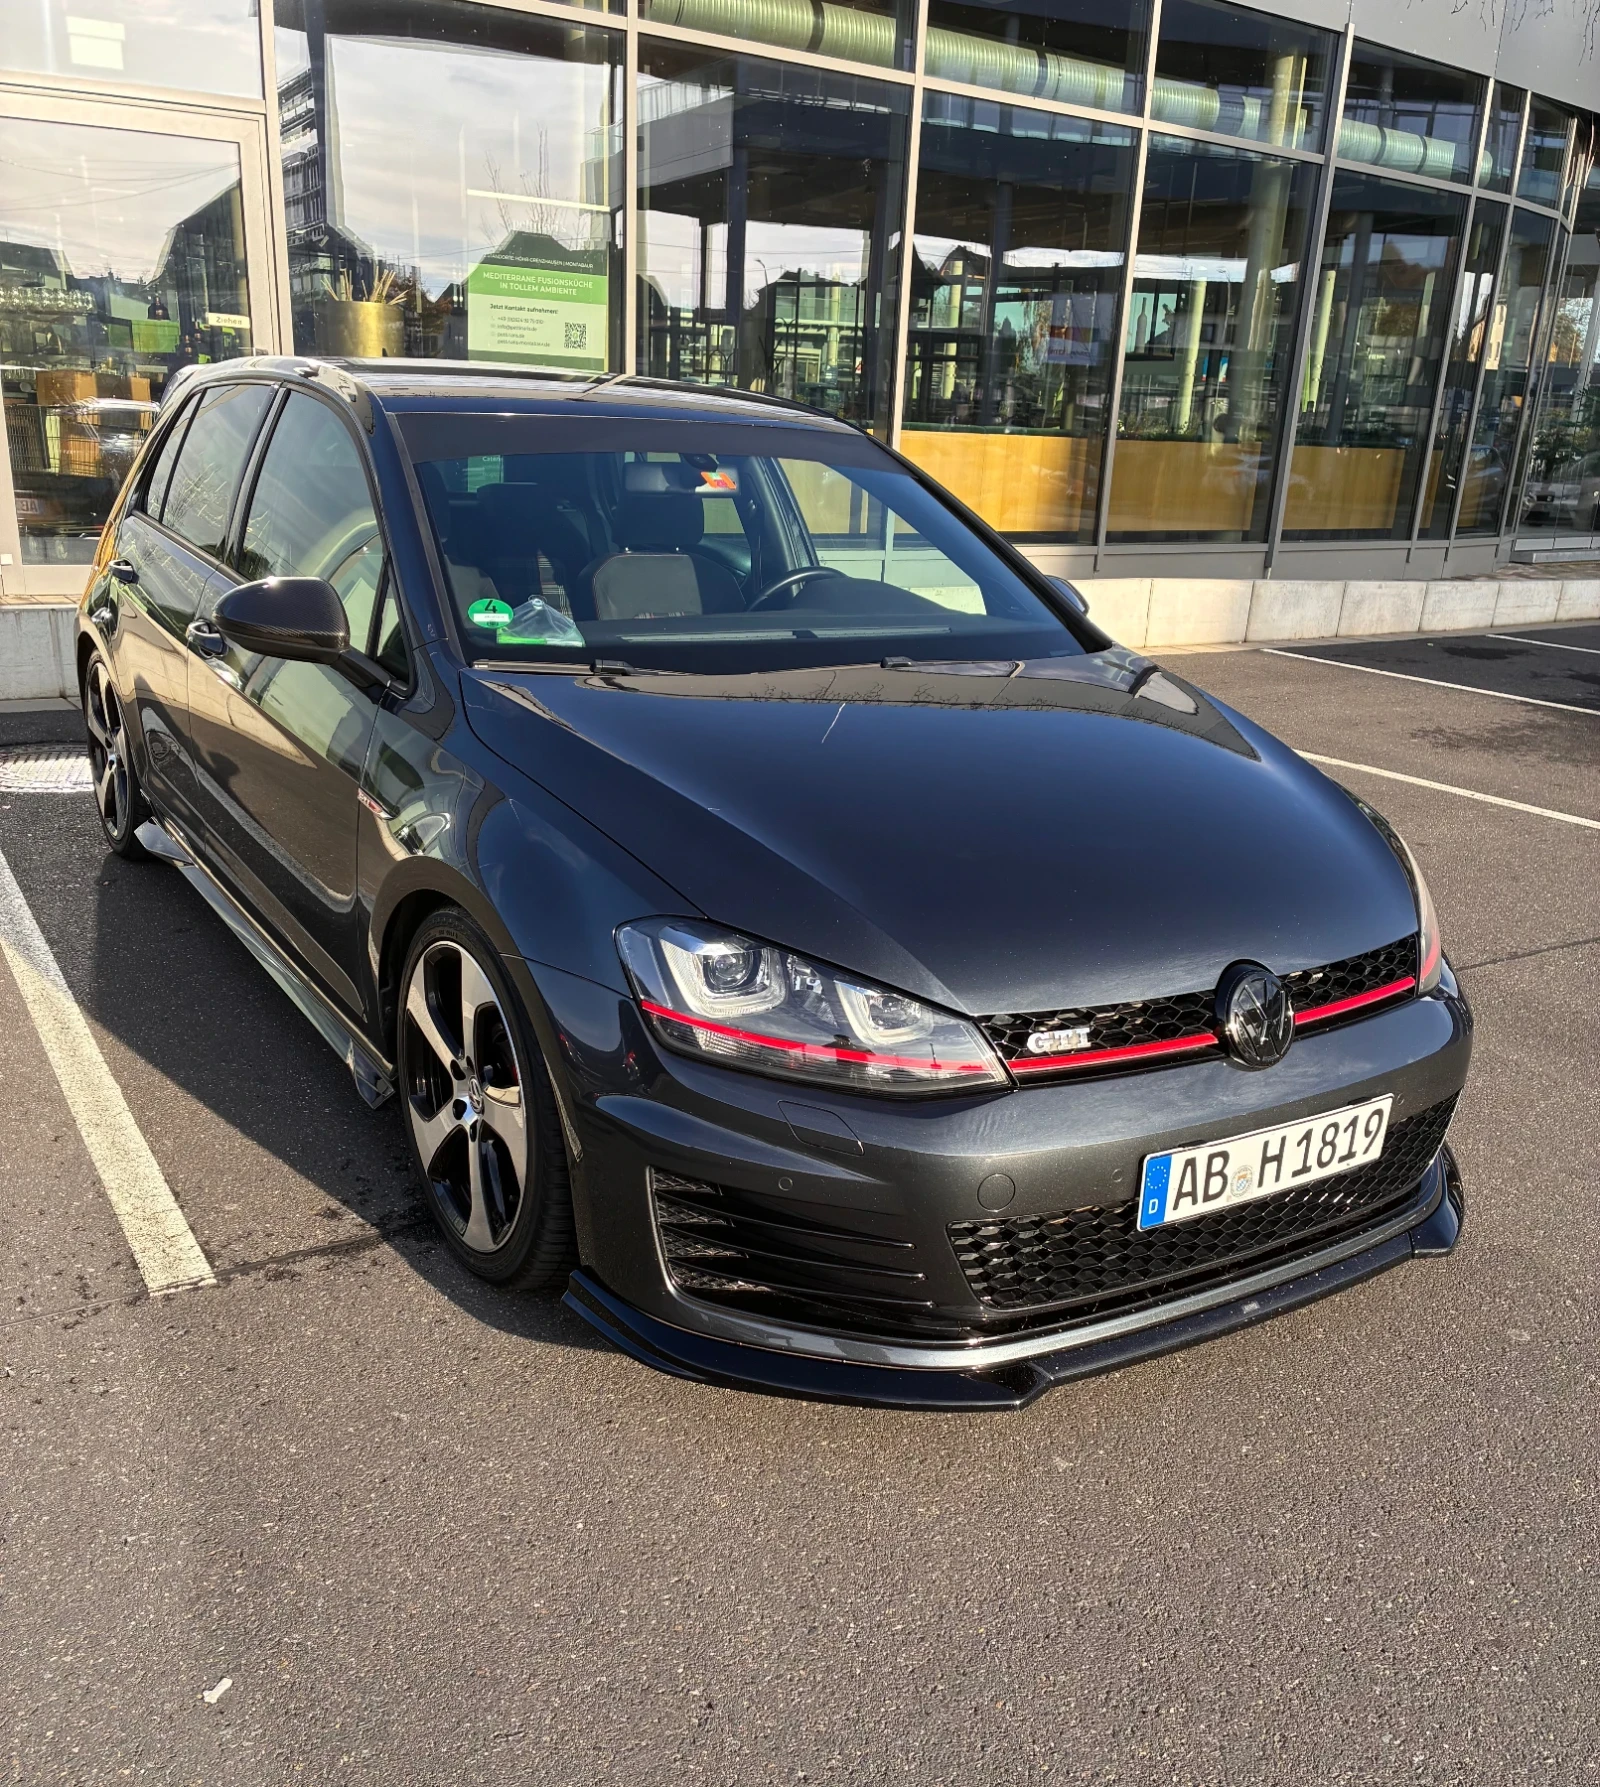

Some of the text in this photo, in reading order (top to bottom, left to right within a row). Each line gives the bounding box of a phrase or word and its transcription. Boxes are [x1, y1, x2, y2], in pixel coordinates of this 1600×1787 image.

[565, 261, 593, 269] MONTABAUR
[483, 272, 593, 289] MEDITERRANE FUSIONSKÜCHE
[510, 282, 538, 292] TOLLEM
[540, 286, 577, 296] AMBIENTE
[504, 304, 526, 312] Kontakt
[216, 316, 242, 325] Ziehen
[485, 599, 498, 613] 4
[1027, 1028, 1091, 1054] GTI
[1172, 1150, 1230, 1211] AB
[1257, 1135, 1287, 1188] H
[1290, 1108, 1385, 1178] 1819
[1148, 1199, 1159, 1214] D
